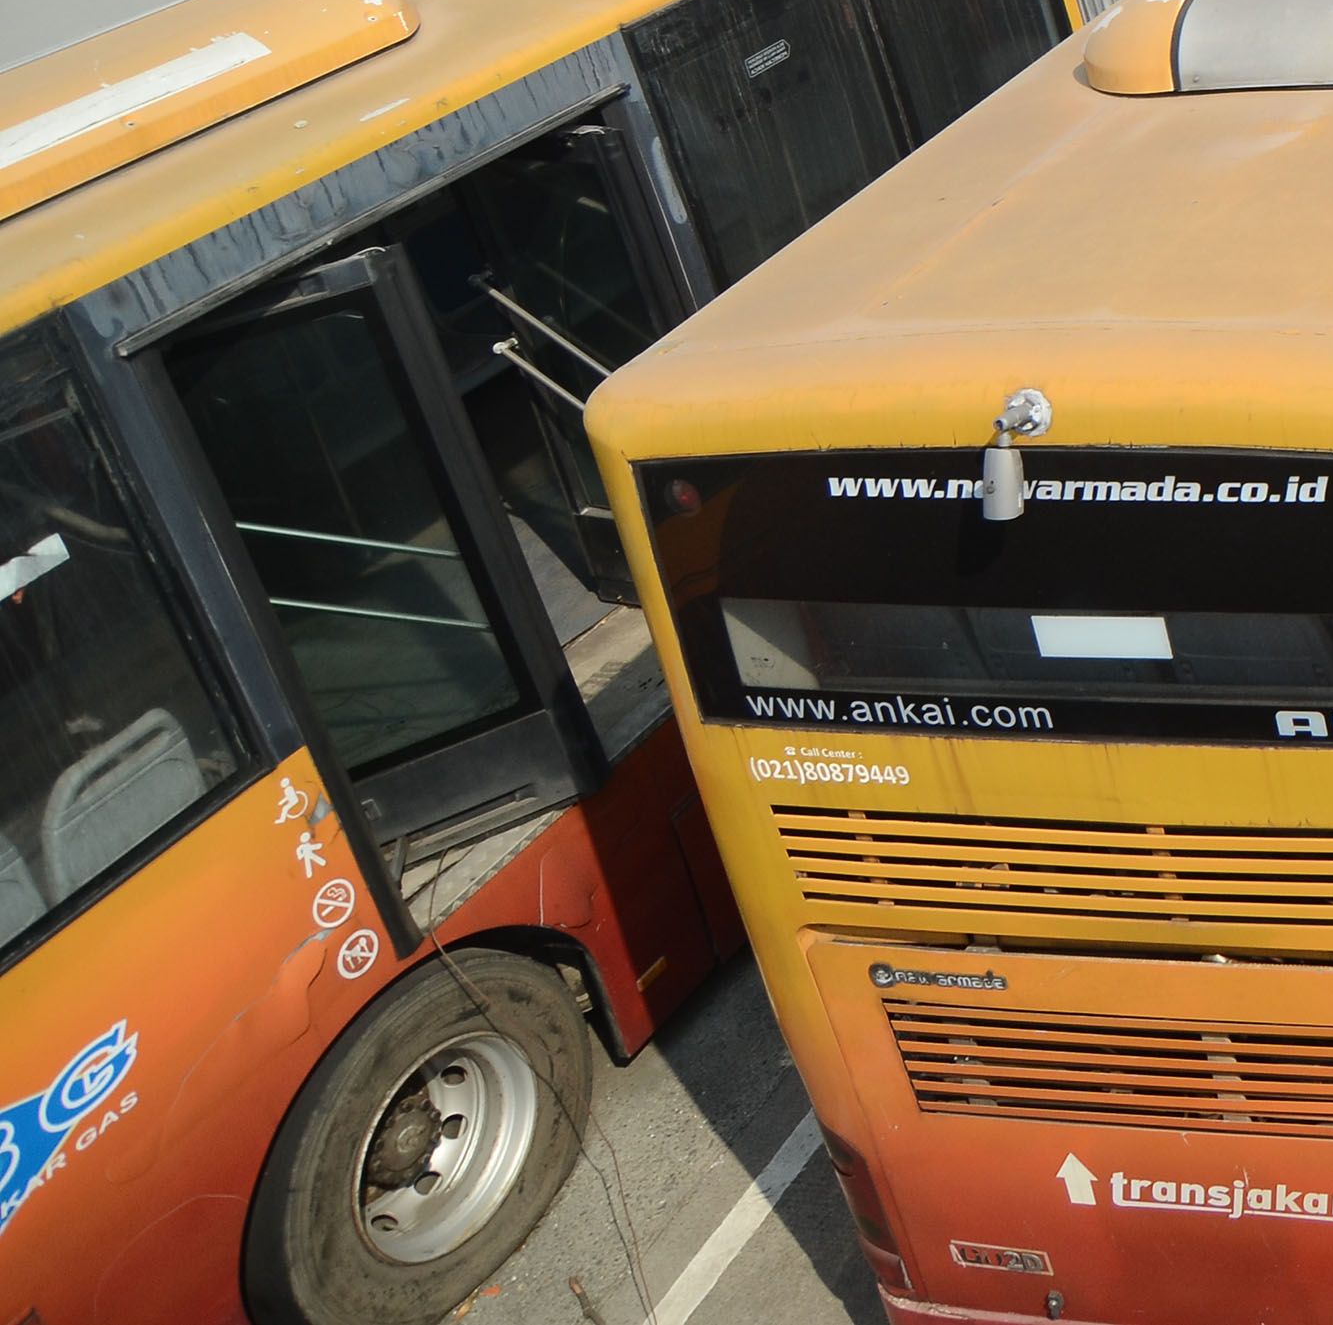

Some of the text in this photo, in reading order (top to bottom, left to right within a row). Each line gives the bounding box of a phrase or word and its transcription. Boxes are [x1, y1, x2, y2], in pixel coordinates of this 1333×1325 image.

[745, 694, 1054, 730] www.ankai.com
[800, 747, 820, 757] Call
[821, 748, 856, 759] Center
[749, 756, 911, 785] (021)80879449
[75, 1090, 139, 1152] GAS
